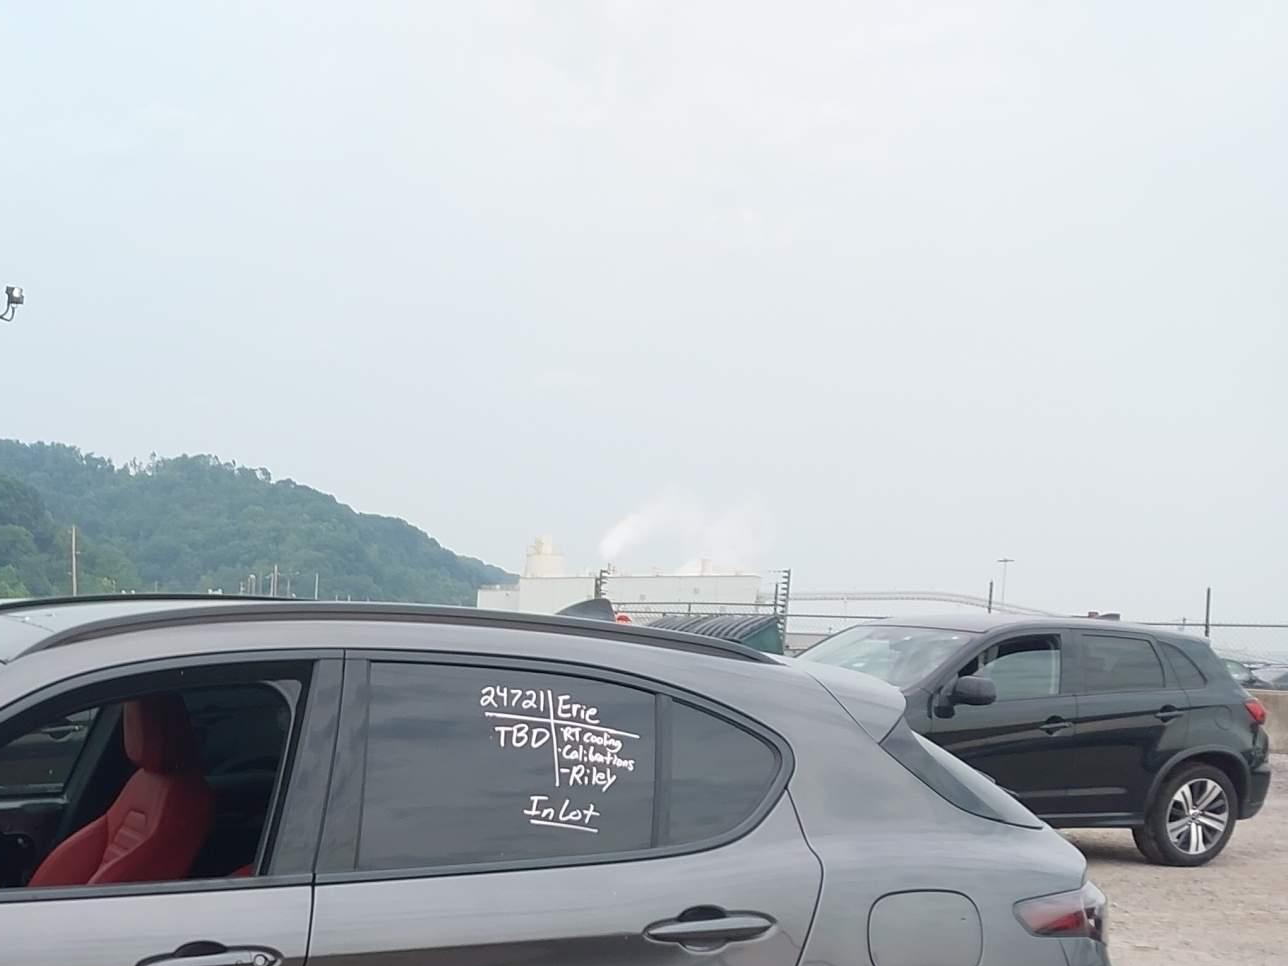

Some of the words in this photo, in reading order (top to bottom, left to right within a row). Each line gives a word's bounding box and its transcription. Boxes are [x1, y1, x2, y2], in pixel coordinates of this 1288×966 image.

[480, 685, 545, 712] 24721
[557, 695, 601, 724] Erie
[494, 724, 551, 748] TBD
[523, 796, 555, 821] In
[559, 800, 600, 823] Lot
